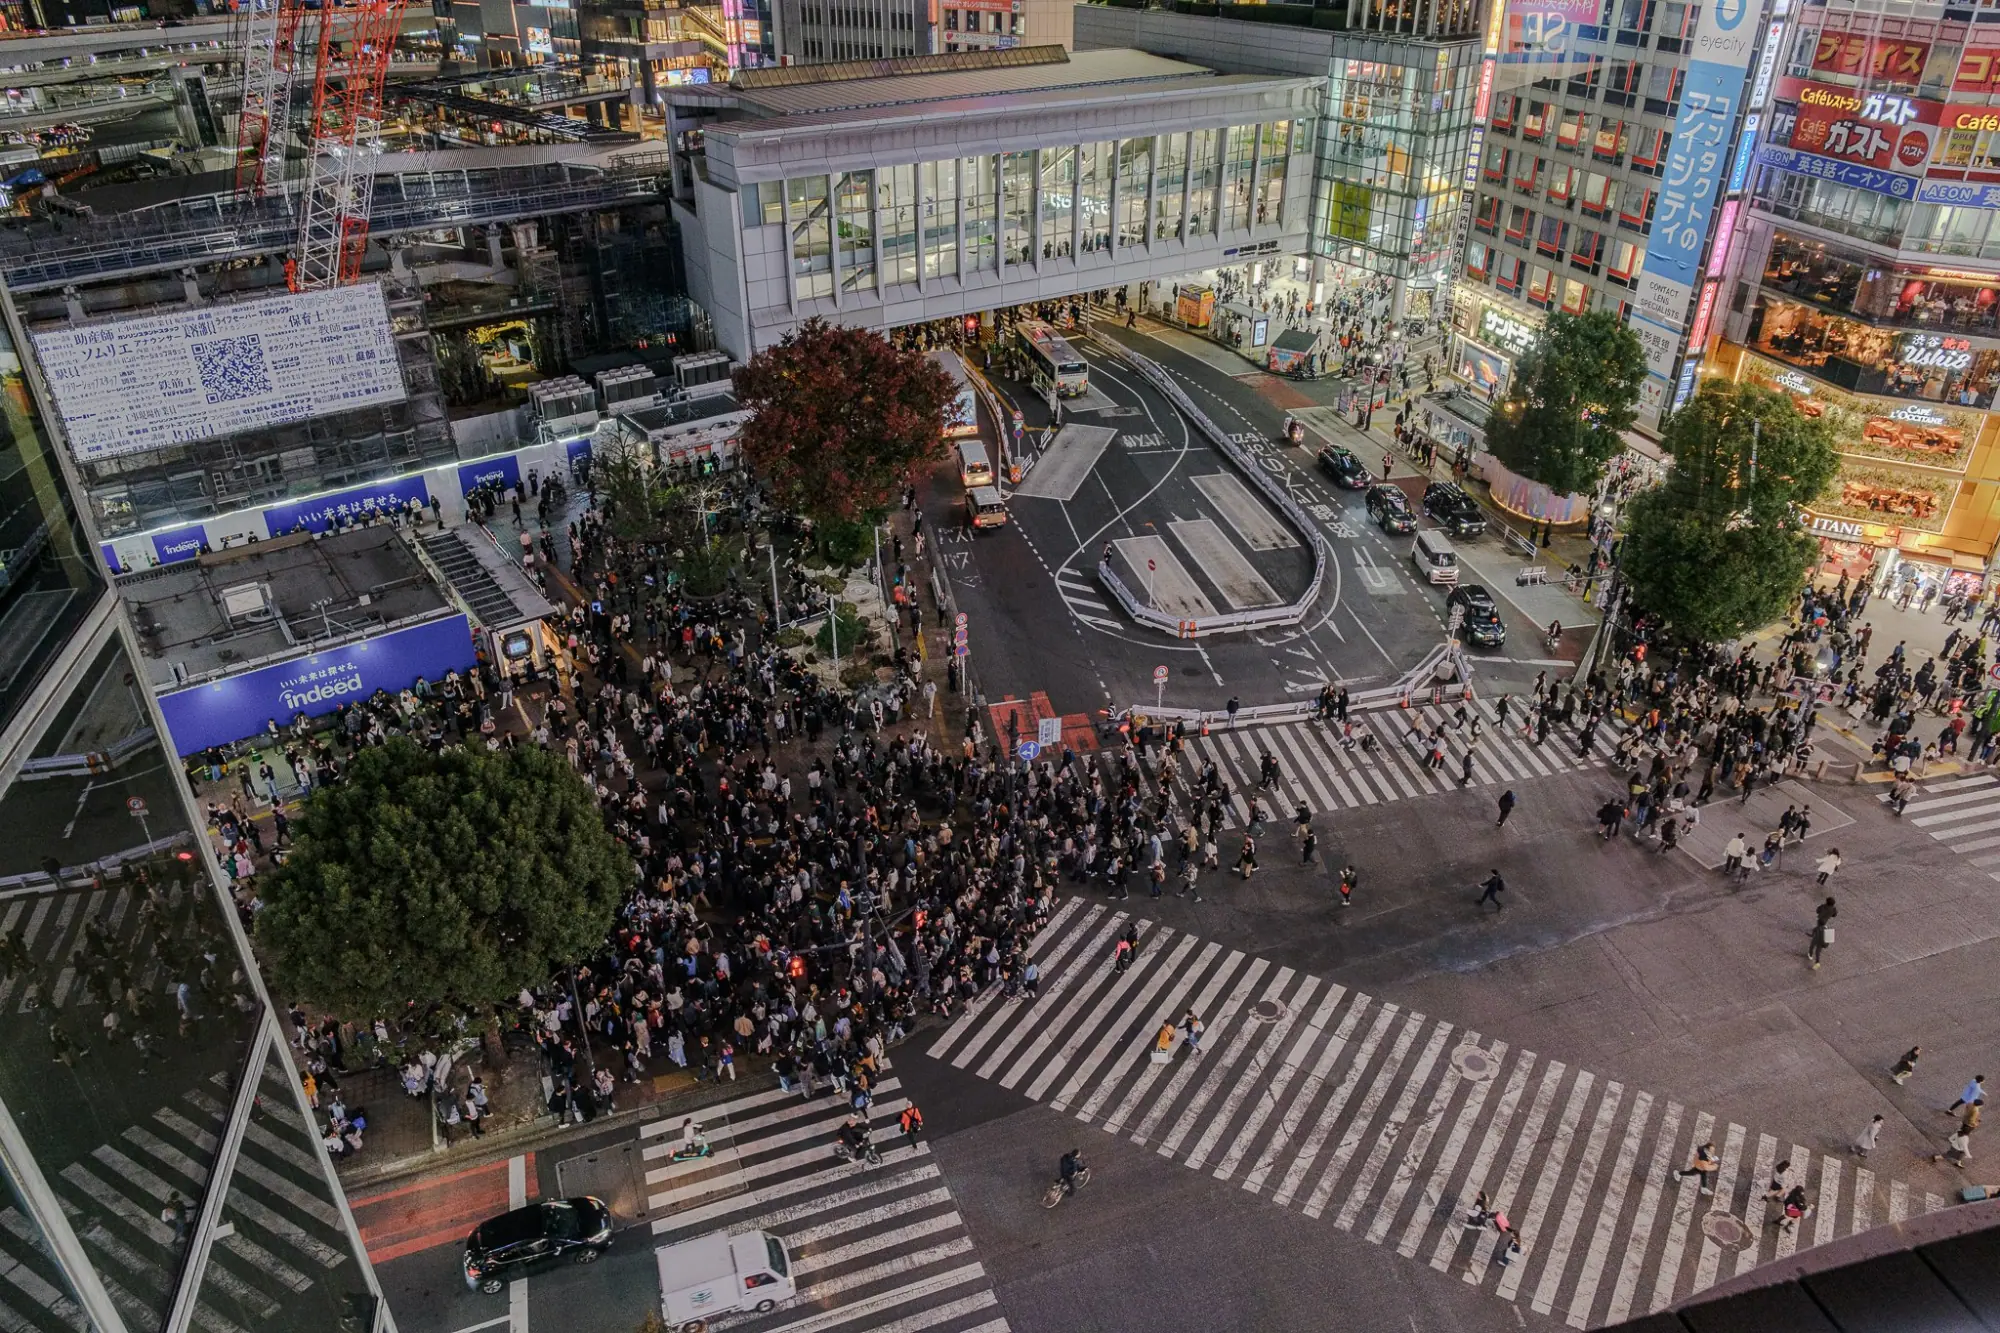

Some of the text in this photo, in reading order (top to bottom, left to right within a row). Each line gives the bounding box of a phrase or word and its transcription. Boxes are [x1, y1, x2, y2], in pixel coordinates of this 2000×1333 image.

[1700, 35, 1747, 56] eyecity
[1817, 36, 1923, 75] プライス
[1755, 43, 1777, 97] 献血ルーム
[1957, 54, 2000, 84] コ
[1860, 93, 1918, 125] ガスト
[1773, 112, 1796, 135] 7F
[1800, 117, 1827, 134] Café
[1823, 119, 1891, 160] ガスト
[1952, 131, 1976, 140] OPEN
[1763, 148, 1790, 167] AEON
[1901, 145, 1925, 158] ガスト
[1660, 91, 1711, 245] アイシティ
[1680, 96, 1731, 251] コンタクトの
[1796, 155, 1906, 194] 英会話イーオン 6F
[1926, 185, 1973, 202] AEON
[1649, 281, 1679, 298] CONTACT
[1653, 294, 1670, 306] LENS
[214, 310, 258, 325] ライフセーバー
[287, 308, 325, 327] 保育士
[1640, 297, 1680, 319] SPECIALISTS
[71, 327, 116, 347] 助産師
[133, 332, 182, 347] アナウンサー
[1485, 310, 1537, 349] サンドラッ
[80, 340, 133, 362] ソムリエ
[1912, 334, 1941, 348] 渋谷
[1904, 345, 1971, 369] Ushi8
[157, 374, 196, 391] 鉄筋工
[1246, 442, 1360, 539] 路線バスのみ
[298, 493, 402, 525] いい未来は探せる。
[164, 539, 200, 555] indeed
[280, 662, 358, 689] いい未来は探せる。
[280, 673, 363, 709] indeed
